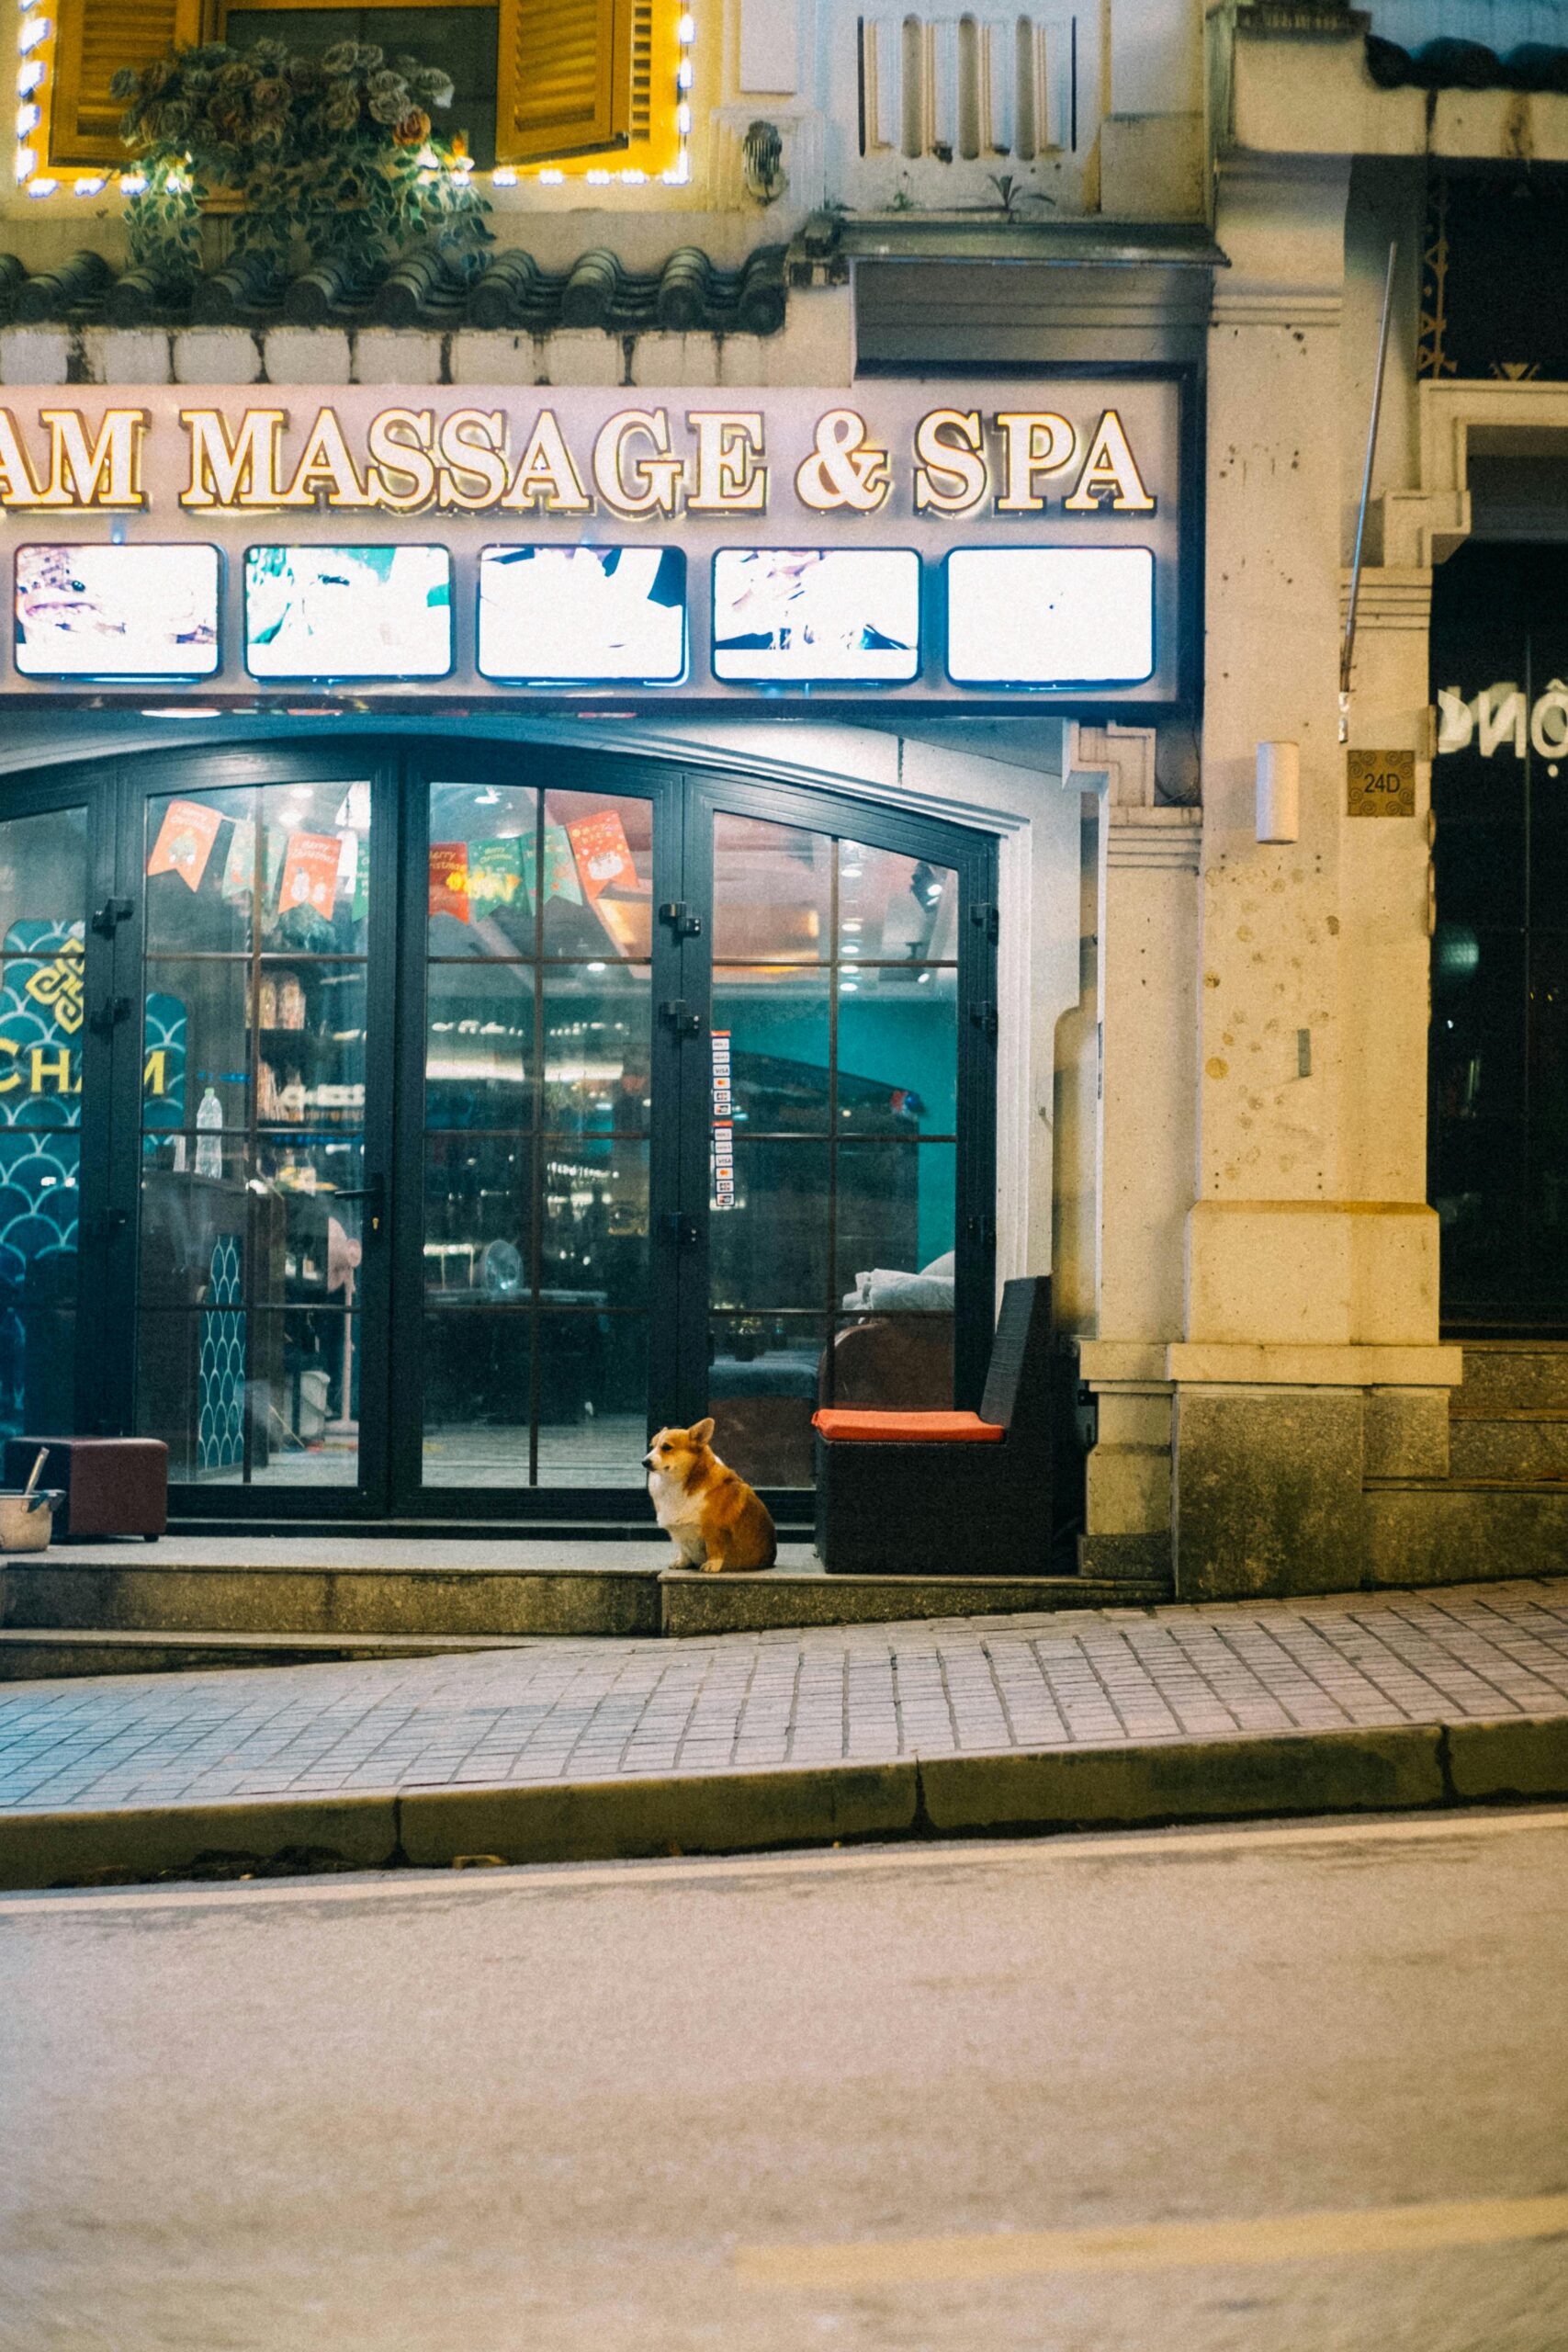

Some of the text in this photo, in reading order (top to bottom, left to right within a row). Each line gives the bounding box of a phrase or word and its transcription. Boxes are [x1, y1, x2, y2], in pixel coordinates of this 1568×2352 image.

[0, 407, 1156, 514] AM MASSAGE & SPA
[1364, 774, 1400, 793] 24D
[0, 1037, 164, 1094] CHM
